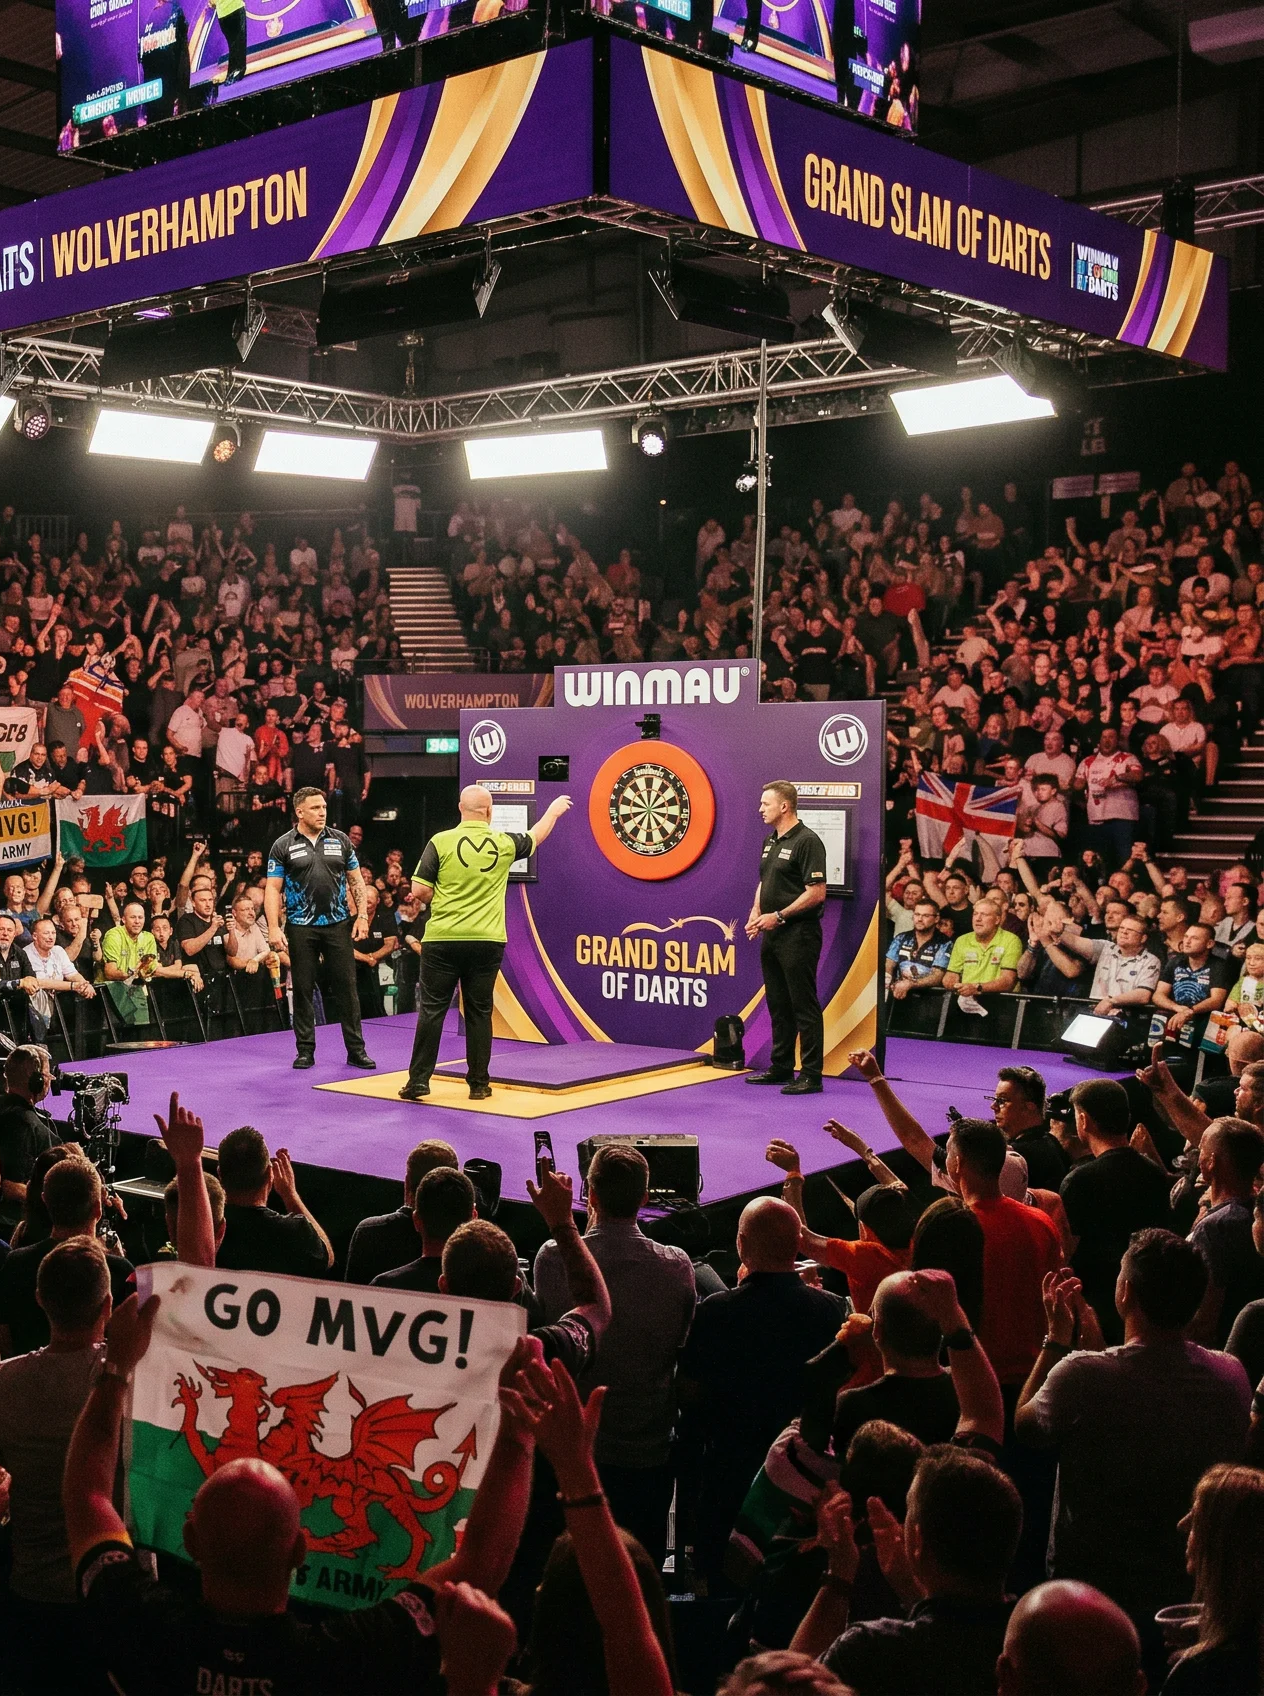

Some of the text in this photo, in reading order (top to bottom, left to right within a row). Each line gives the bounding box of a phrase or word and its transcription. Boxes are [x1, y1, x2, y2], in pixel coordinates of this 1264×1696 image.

[52, 166, 308, 279] WOLVERHAMPTON
[804, 153, 1052, 281] GRAND SLAM OF DARTS
[404, 692, 519, 709] WOLVERHAMPTON
[1, 842, 32, 860] ARMY
[575, 934, 736, 977] GRAND SLAM
[601, 970, 708, 1008] OF DARTS
[203, 1283, 476, 1370] GO MVG!
[316, 1566, 390, 1601] ARMY
[196, 1666, 274, 1696] DARTS
